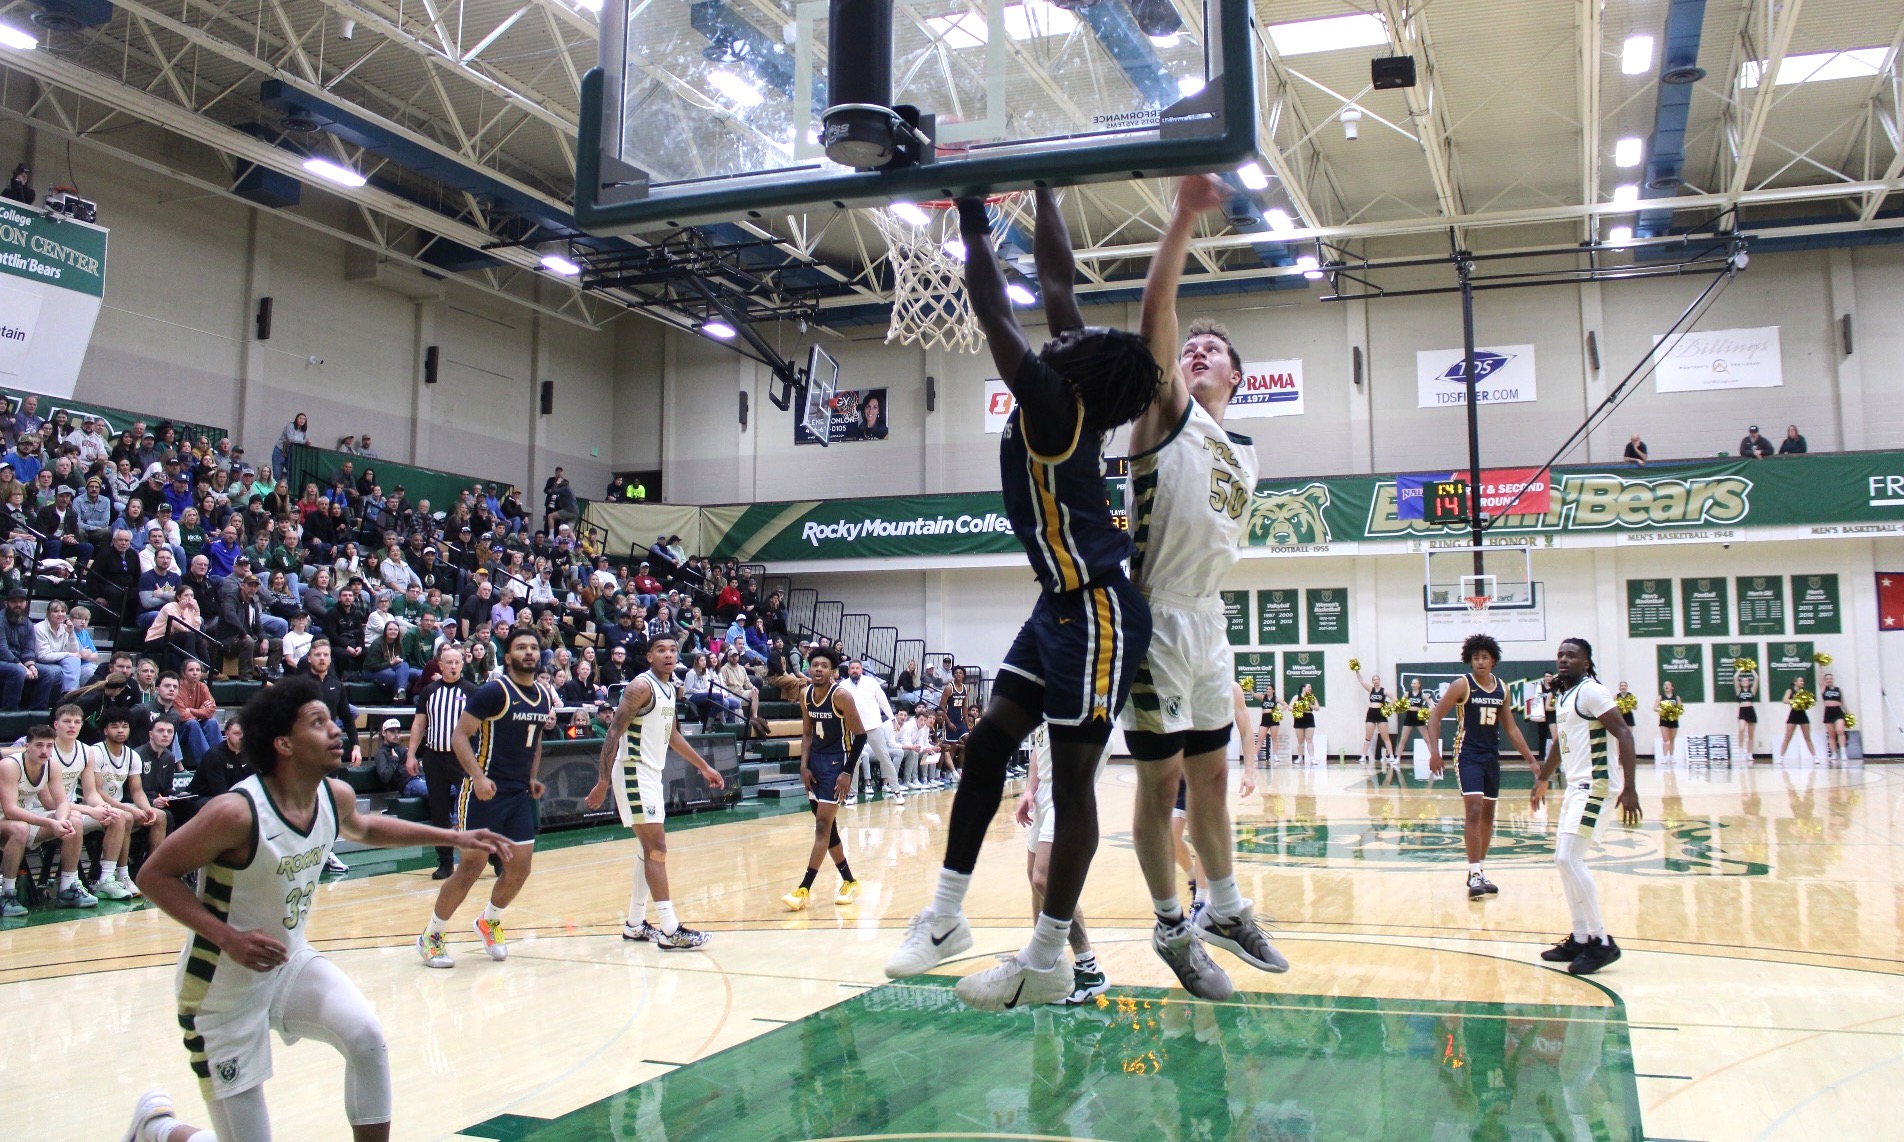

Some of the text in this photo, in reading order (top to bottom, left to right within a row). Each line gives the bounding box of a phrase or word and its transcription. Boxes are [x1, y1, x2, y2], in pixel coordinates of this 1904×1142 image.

[0, 223, 99, 277] ON CENTER
[0, 252, 62, 279] ttlin'Bears
[0, 325, 26, 341] tain
[1247, 394, 1270, 403] 1977
[1435, 388, 1519, 404] TDSFIER.COM
[1209, 467, 1248, 520] 50
[1498, 482, 1545, 494] SECOND
[1868, 475, 1904, 497] FR
[1435, 496, 1460, 517] 14
[1480, 496, 1520, 507] ROUND
[802, 513, 1015, 547] Rocky Mountain Colleg
[1627, 533, 1654, 541] MEN'S
[1811, 524, 1904, 535] MEN'S BASKETBALL-
[1489, 537, 1537, 547] HONOR
[1480, 707, 1497, 726] 15
[525, 724, 538, 748] 1
[816, 721, 825, 739] 4
[276, 844, 326, 881] ROCKY
